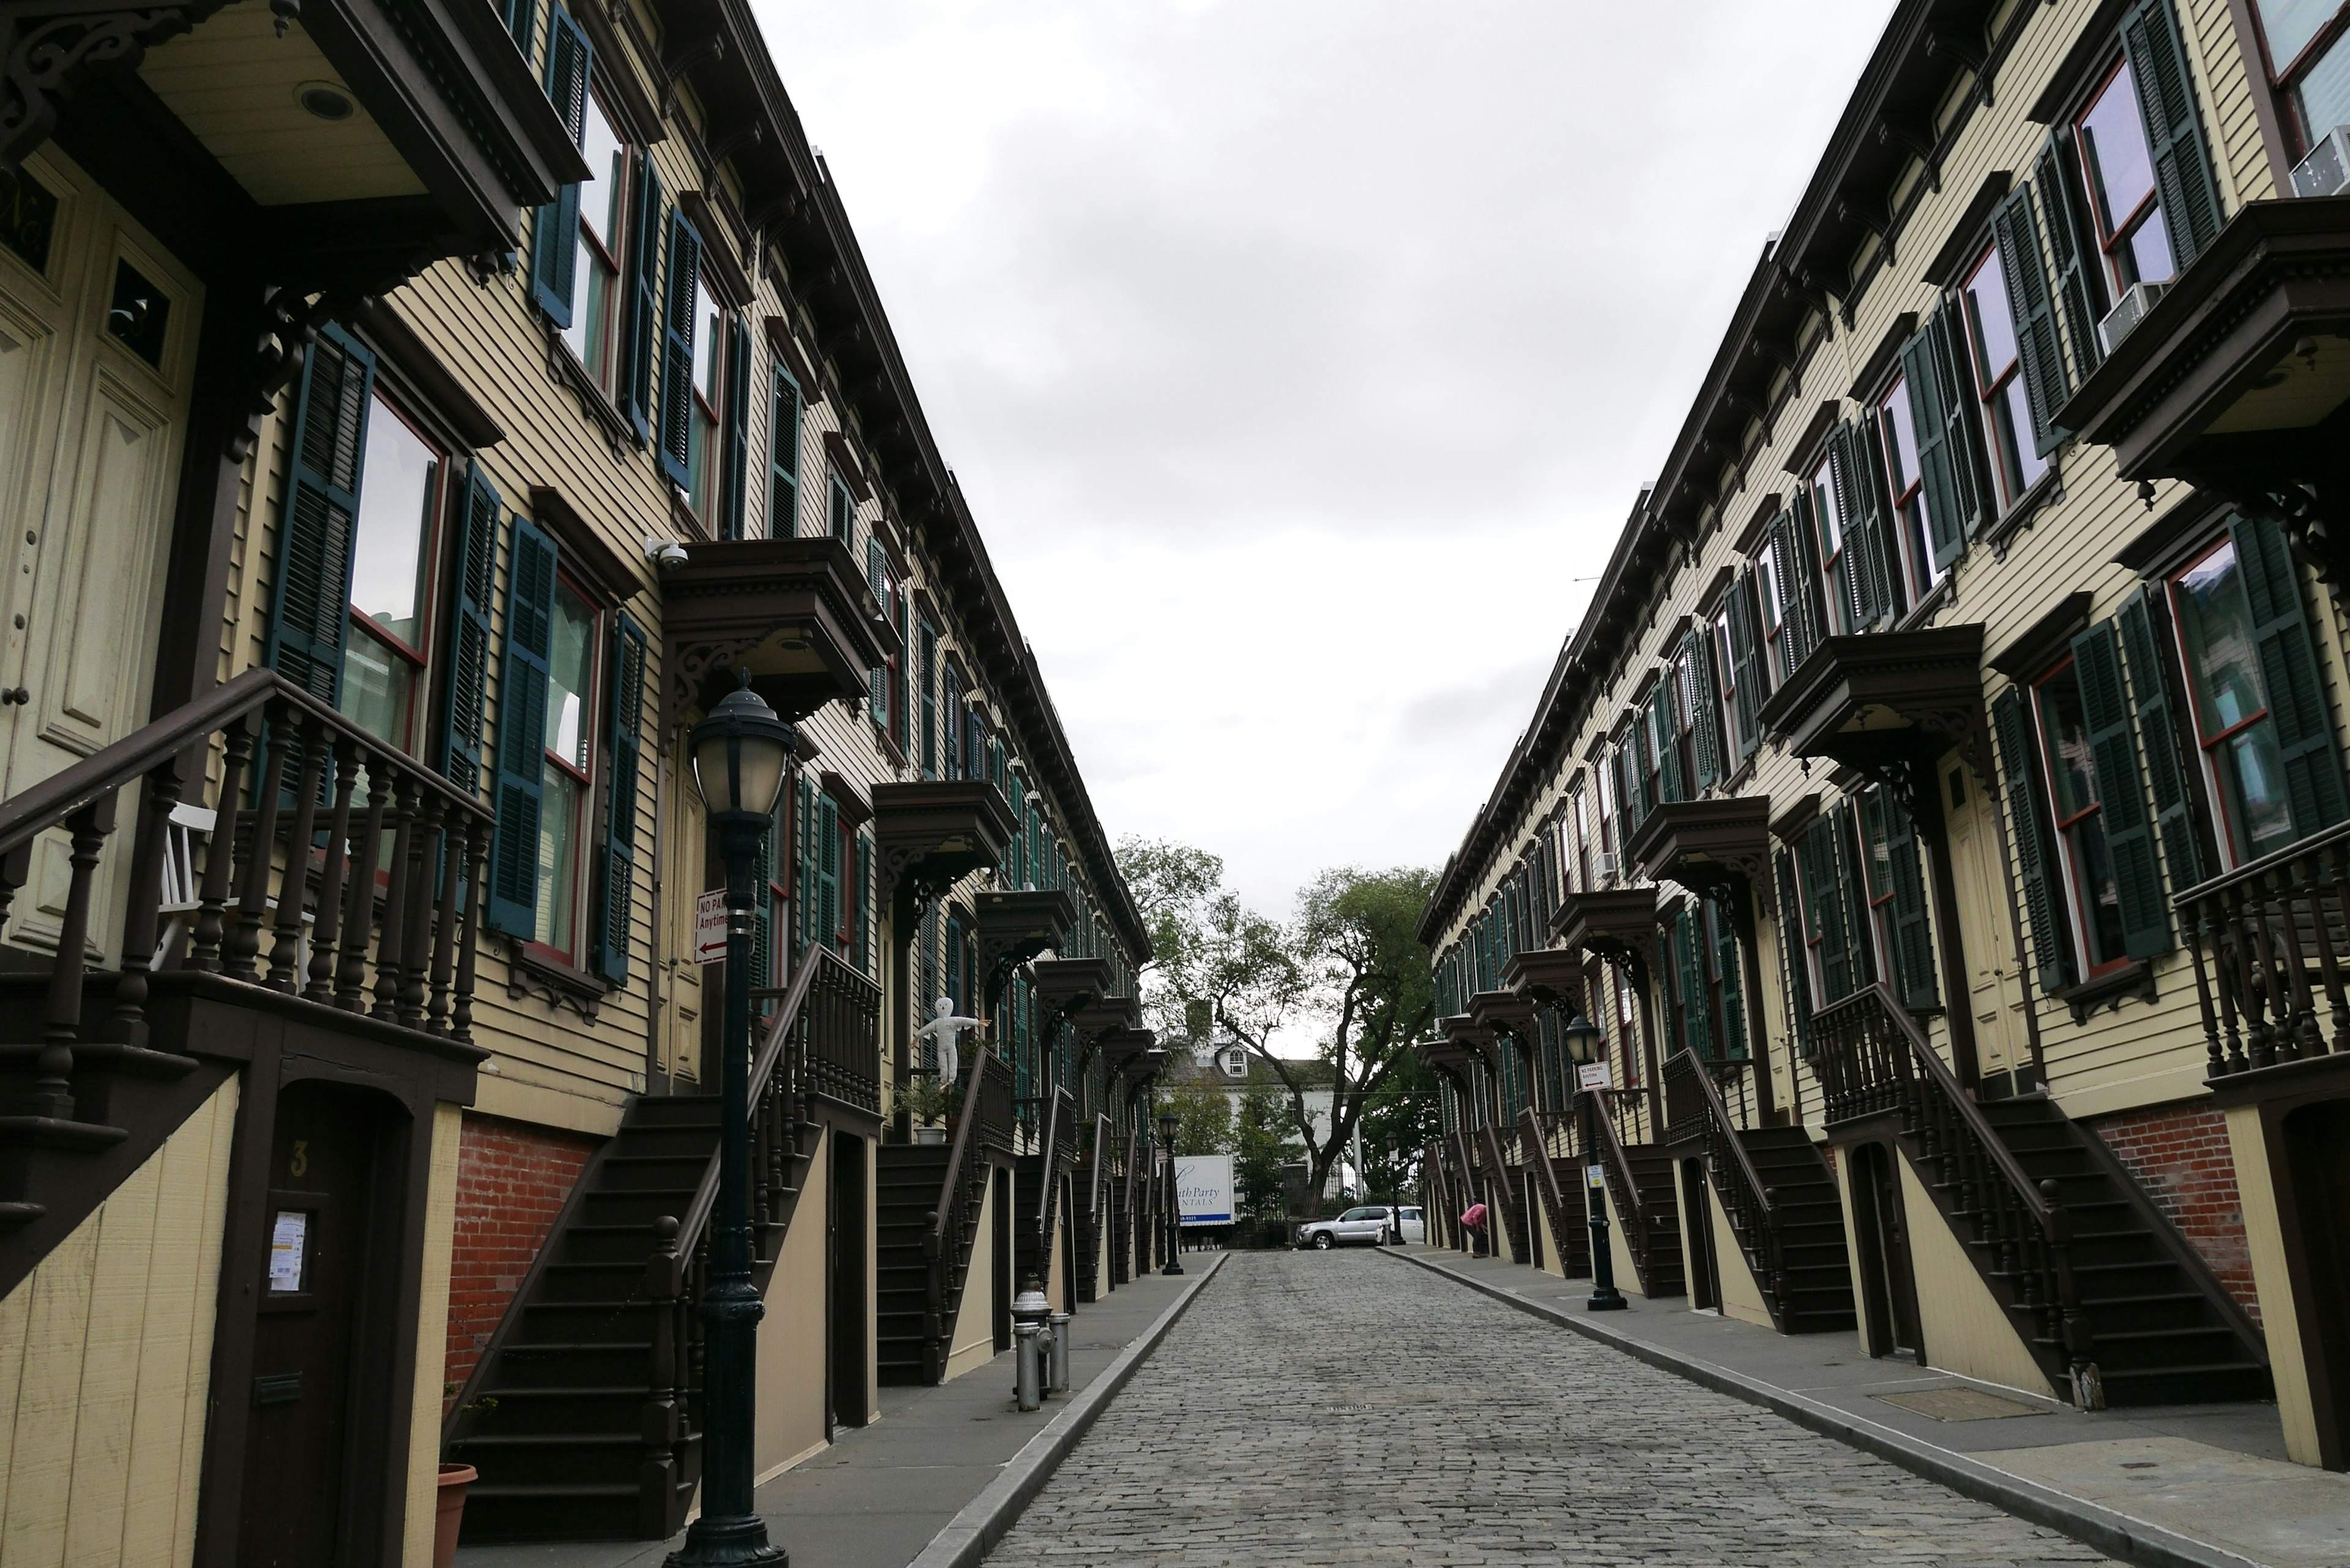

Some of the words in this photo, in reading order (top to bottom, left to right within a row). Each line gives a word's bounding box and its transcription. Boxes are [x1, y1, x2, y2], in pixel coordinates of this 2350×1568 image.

[700, 901, 710, 913] NO
[712, 898, 726, 911] PAR
[700, 914, 728, 930] Anytime
[291, 1140, 308, 1177] 3
[1179, 1187, 1192, 1198] ith
[1193, 1187, 1219, 1199] Party
